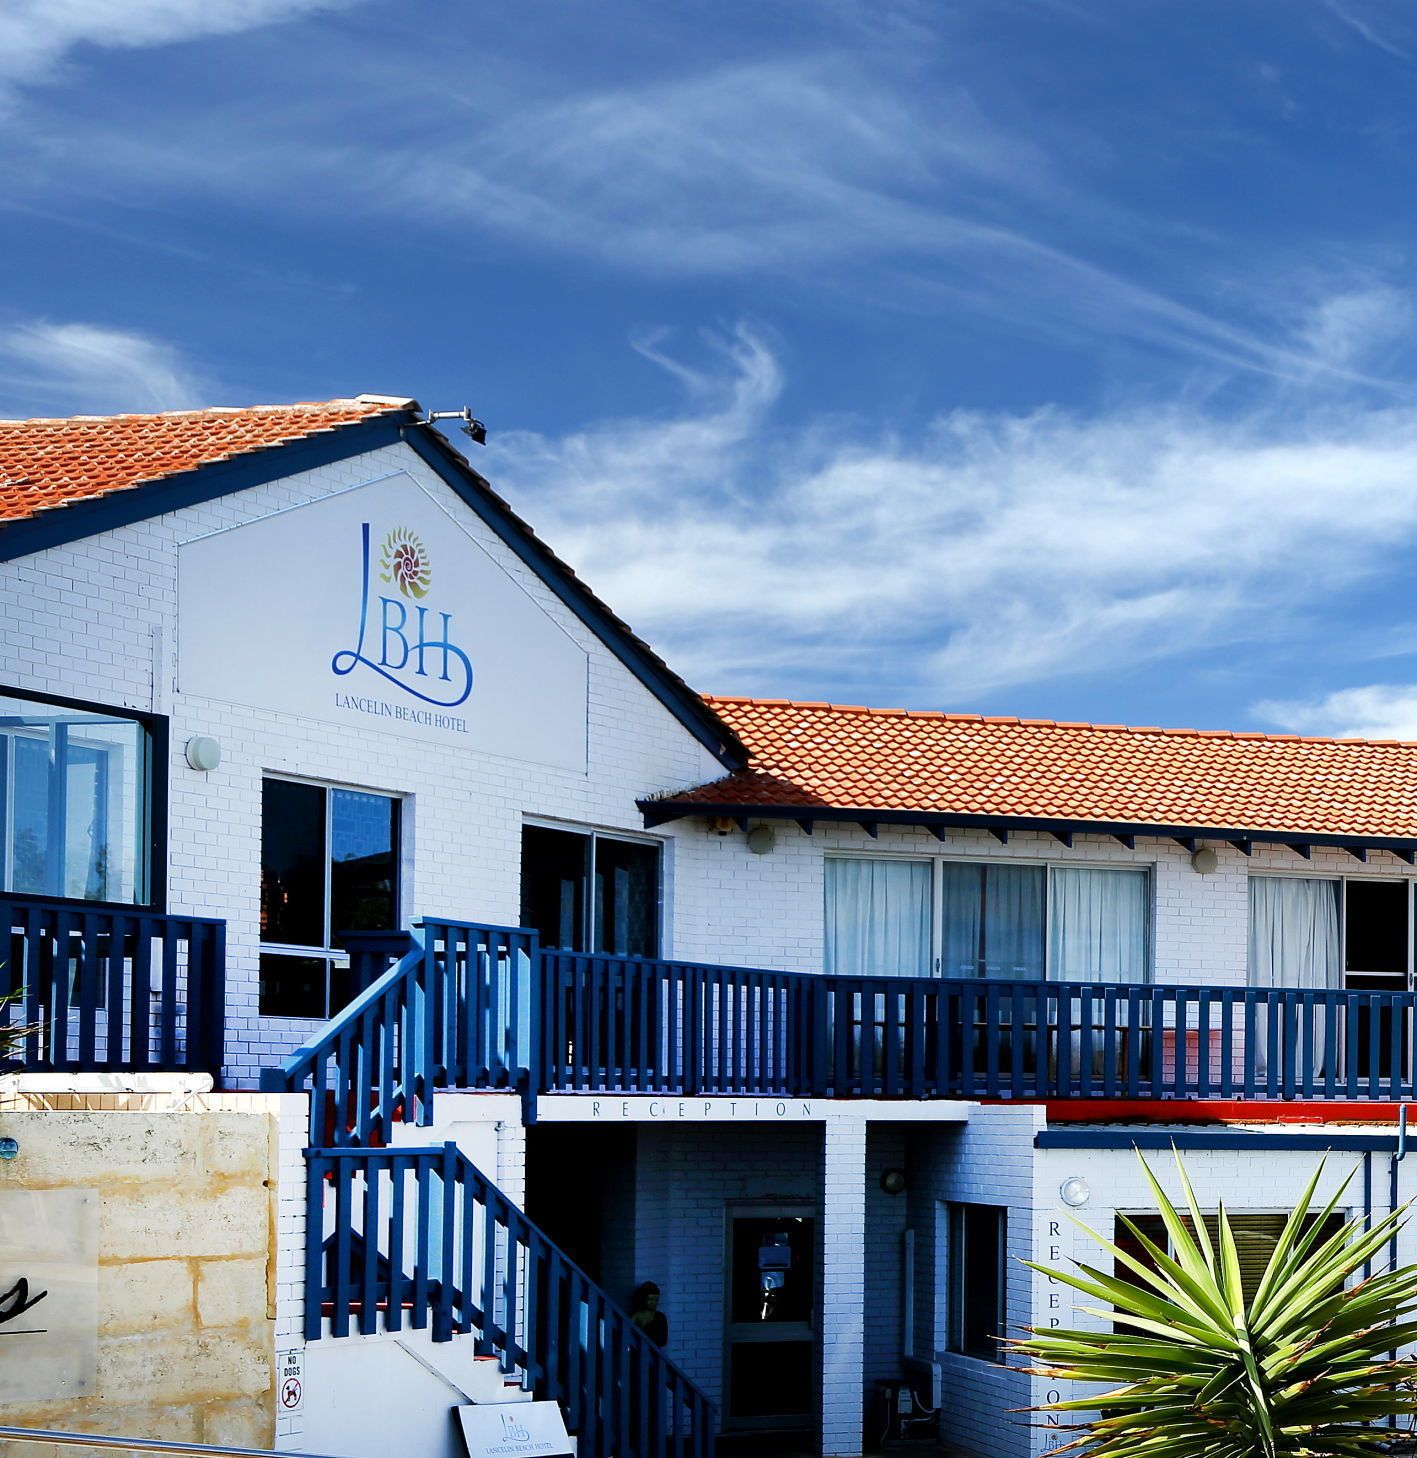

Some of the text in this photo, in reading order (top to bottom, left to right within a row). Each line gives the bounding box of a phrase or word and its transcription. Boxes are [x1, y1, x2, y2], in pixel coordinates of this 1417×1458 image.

[331, 522, 473, 707] LBH
[335, 692, 469, 733] LANCELIN BEACH HOTEL
[592, 1101, 812, 1117] RECEPTION
[288, 1356, 297, 1365] NO
[284, 1367, 300, 1376] DOGS
[486, 1442, 554, 1455] LANCELIN BEACH HOTEL
